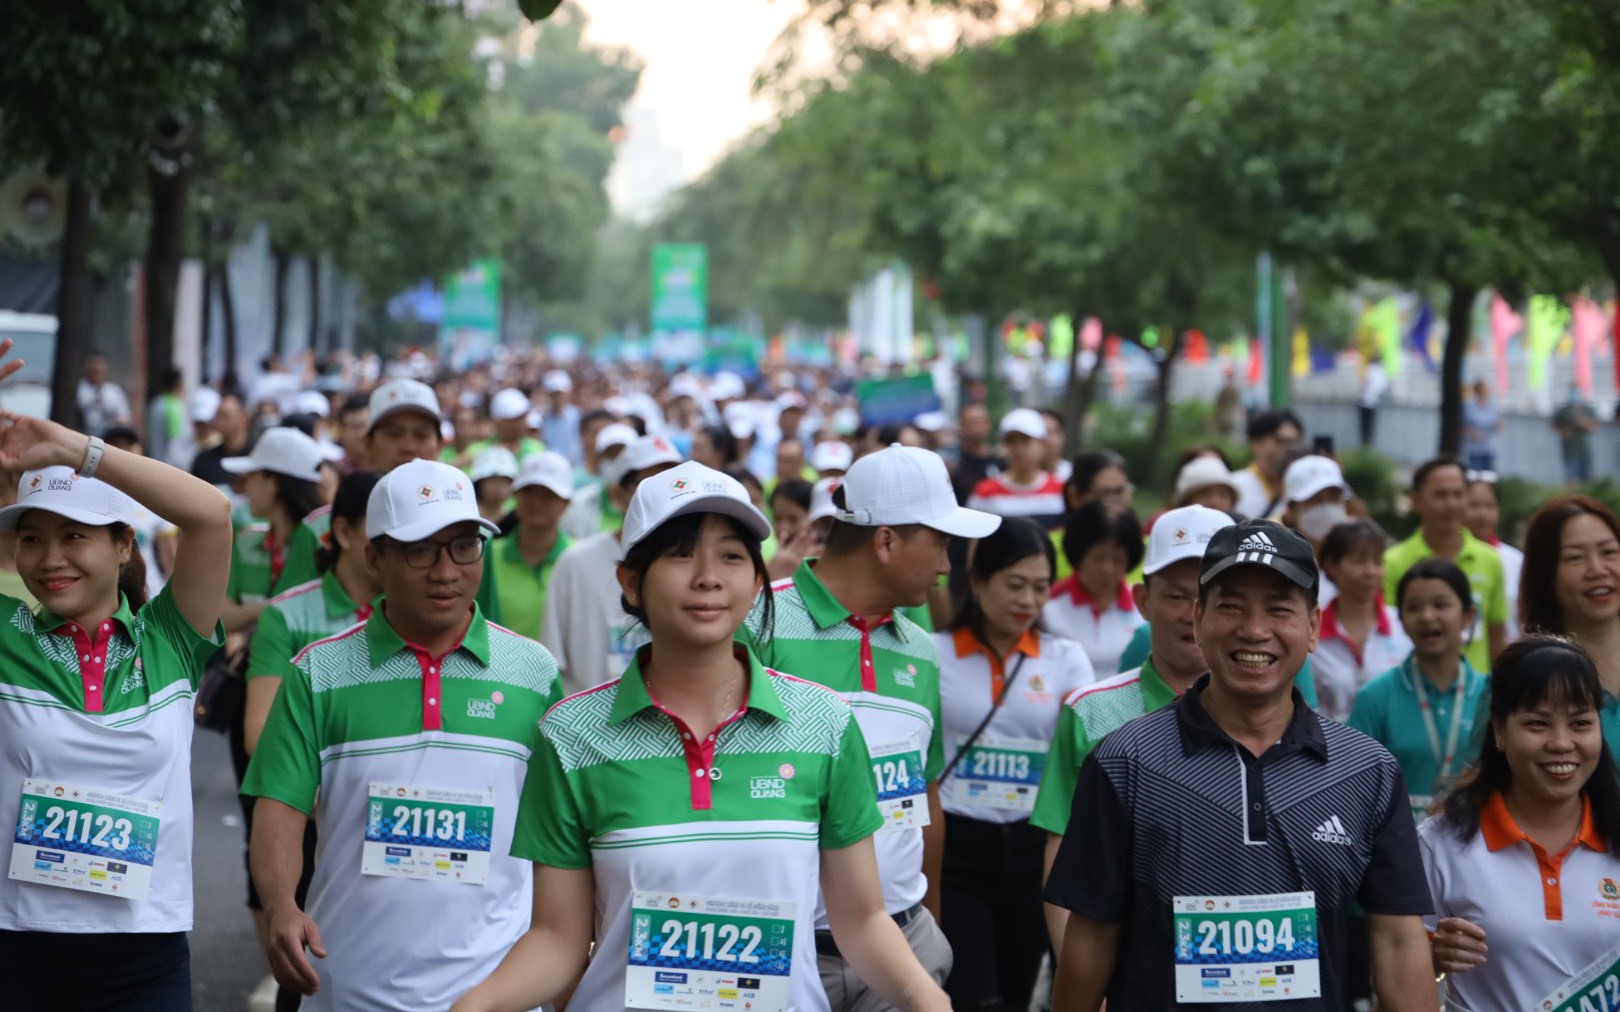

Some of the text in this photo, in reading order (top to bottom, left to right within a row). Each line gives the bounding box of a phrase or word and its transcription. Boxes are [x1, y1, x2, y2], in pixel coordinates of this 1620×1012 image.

[1238, 541, 1278, 553] adidas
[467, 700, 496, 710] UBND
[974, 751, 1030, 780] 21113
[750, 778, 786, 790] UBND
[43, 805, 133, 851] 21123
[391, 805, 467, 841] 21131
[1312, 829, 1352, 846] adidas
[660, 919, 763, 963] 21122
[1197, 917, 1296, 955] 21094
